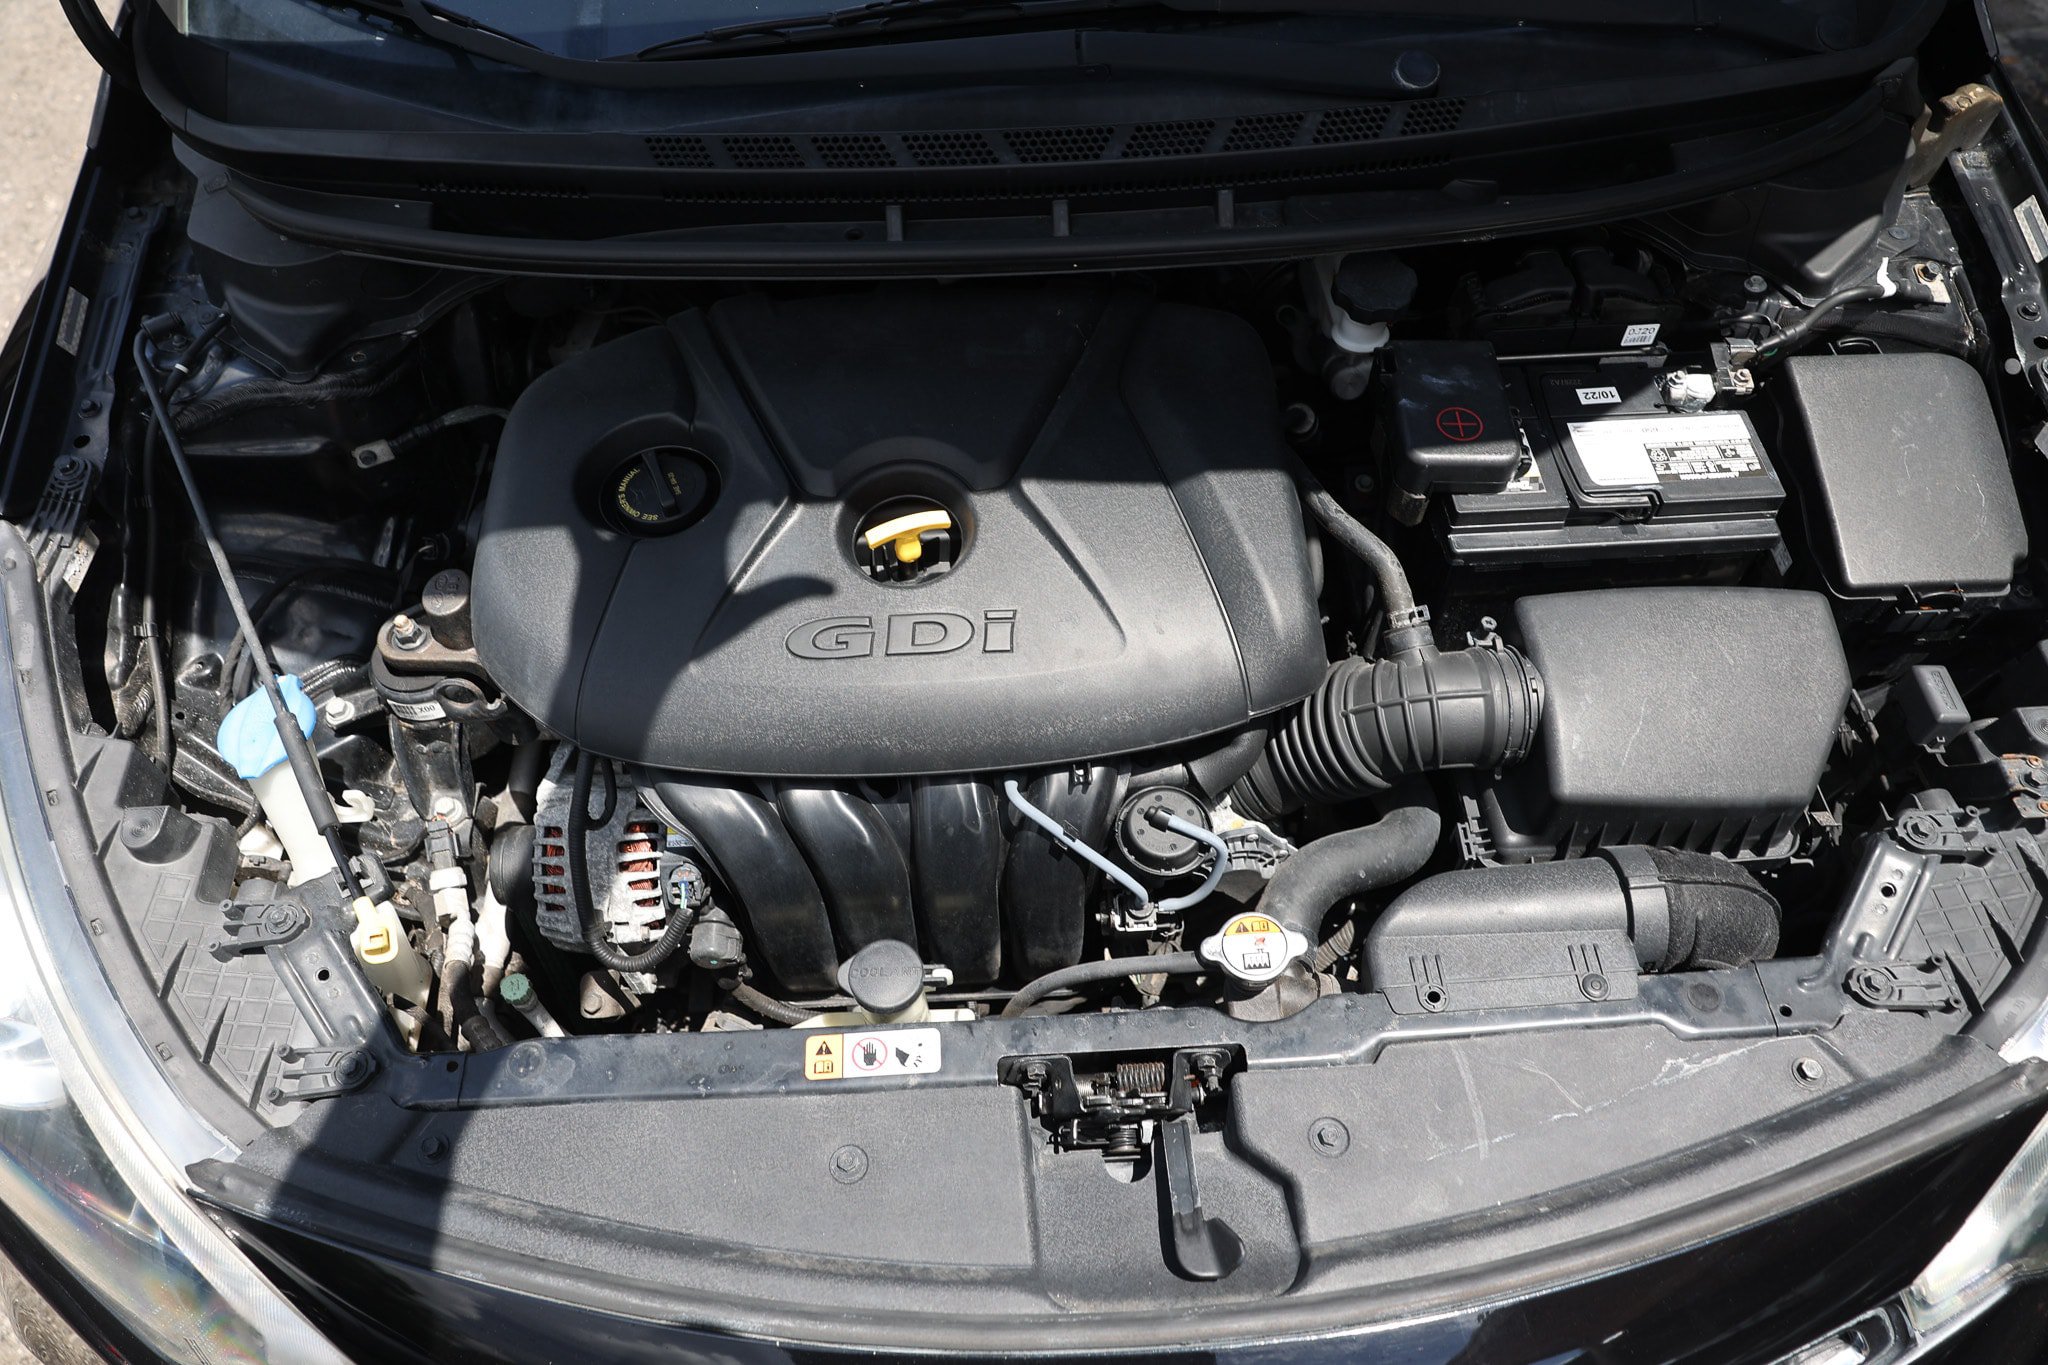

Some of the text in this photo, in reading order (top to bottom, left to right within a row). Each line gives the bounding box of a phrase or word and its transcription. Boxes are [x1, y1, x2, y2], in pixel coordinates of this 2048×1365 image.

[1583, 391, 1616, 400] 10/22
[617, 467, 641, 493] MANUAL
[641, 513, 659, 521] SEE
[784, 609, 1017, 659] GDi
[850, 966, 921, 979] COOLANT
